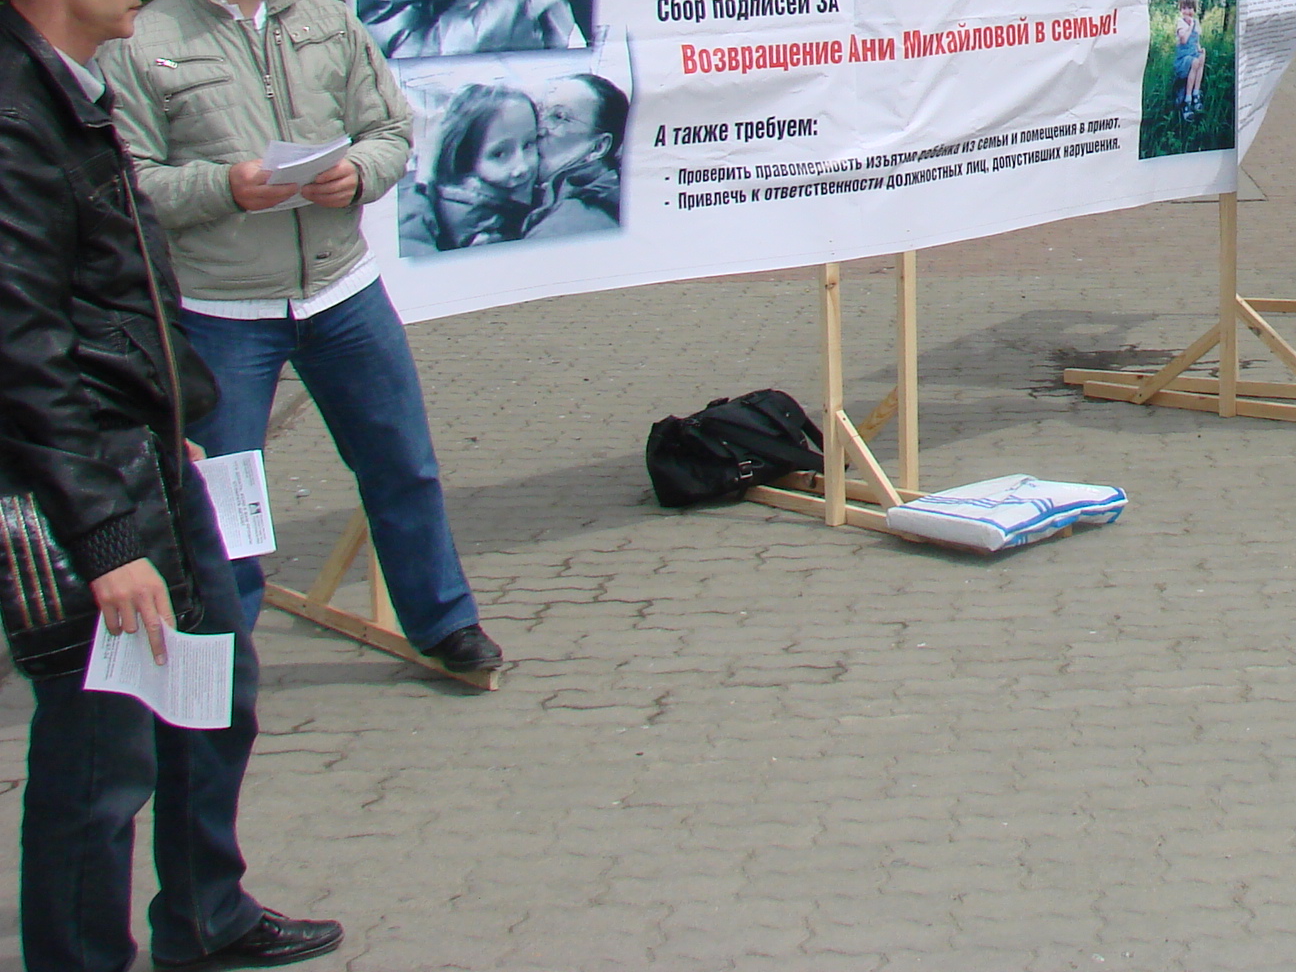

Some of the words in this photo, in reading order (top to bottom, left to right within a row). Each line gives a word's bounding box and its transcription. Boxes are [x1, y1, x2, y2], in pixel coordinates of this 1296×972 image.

[681, 39, 843, 75] Возвращение
[848, 34, 896, 64] Ани
[903, 23, 1030, 60] Михайловой
[1035, 21, 1046, 44] в
[1051, 8, 1118, 42] семью!
[654, 124, 666, 147] А
[672, 122, 729, 146] также
[734, 116, 819, 143] требуем:
[678, 166, 752, 186] Проверить
[755, 157, 863, 180] правомерность
[961, 139, 976, 155] из
[977, 132, 1009, 151] семьи
[1010, 131, 1018, 145] и
[1020, 124, 1078, 144] помещения
[1079, 123, 1086, 135] в
[1087, 117, 1121, 135] приют.
[678, 191, 747, 211] Привлечь
[751, 188, 760, 202] к
[764, 176, 884, 201] ответственности
[886, 164, 963, 190] должностных
[965, 157, 990, 176] лиц,
[992, 147, 1061, 172] допустивших
[1063, 137, 1121, 159] нарушения.
